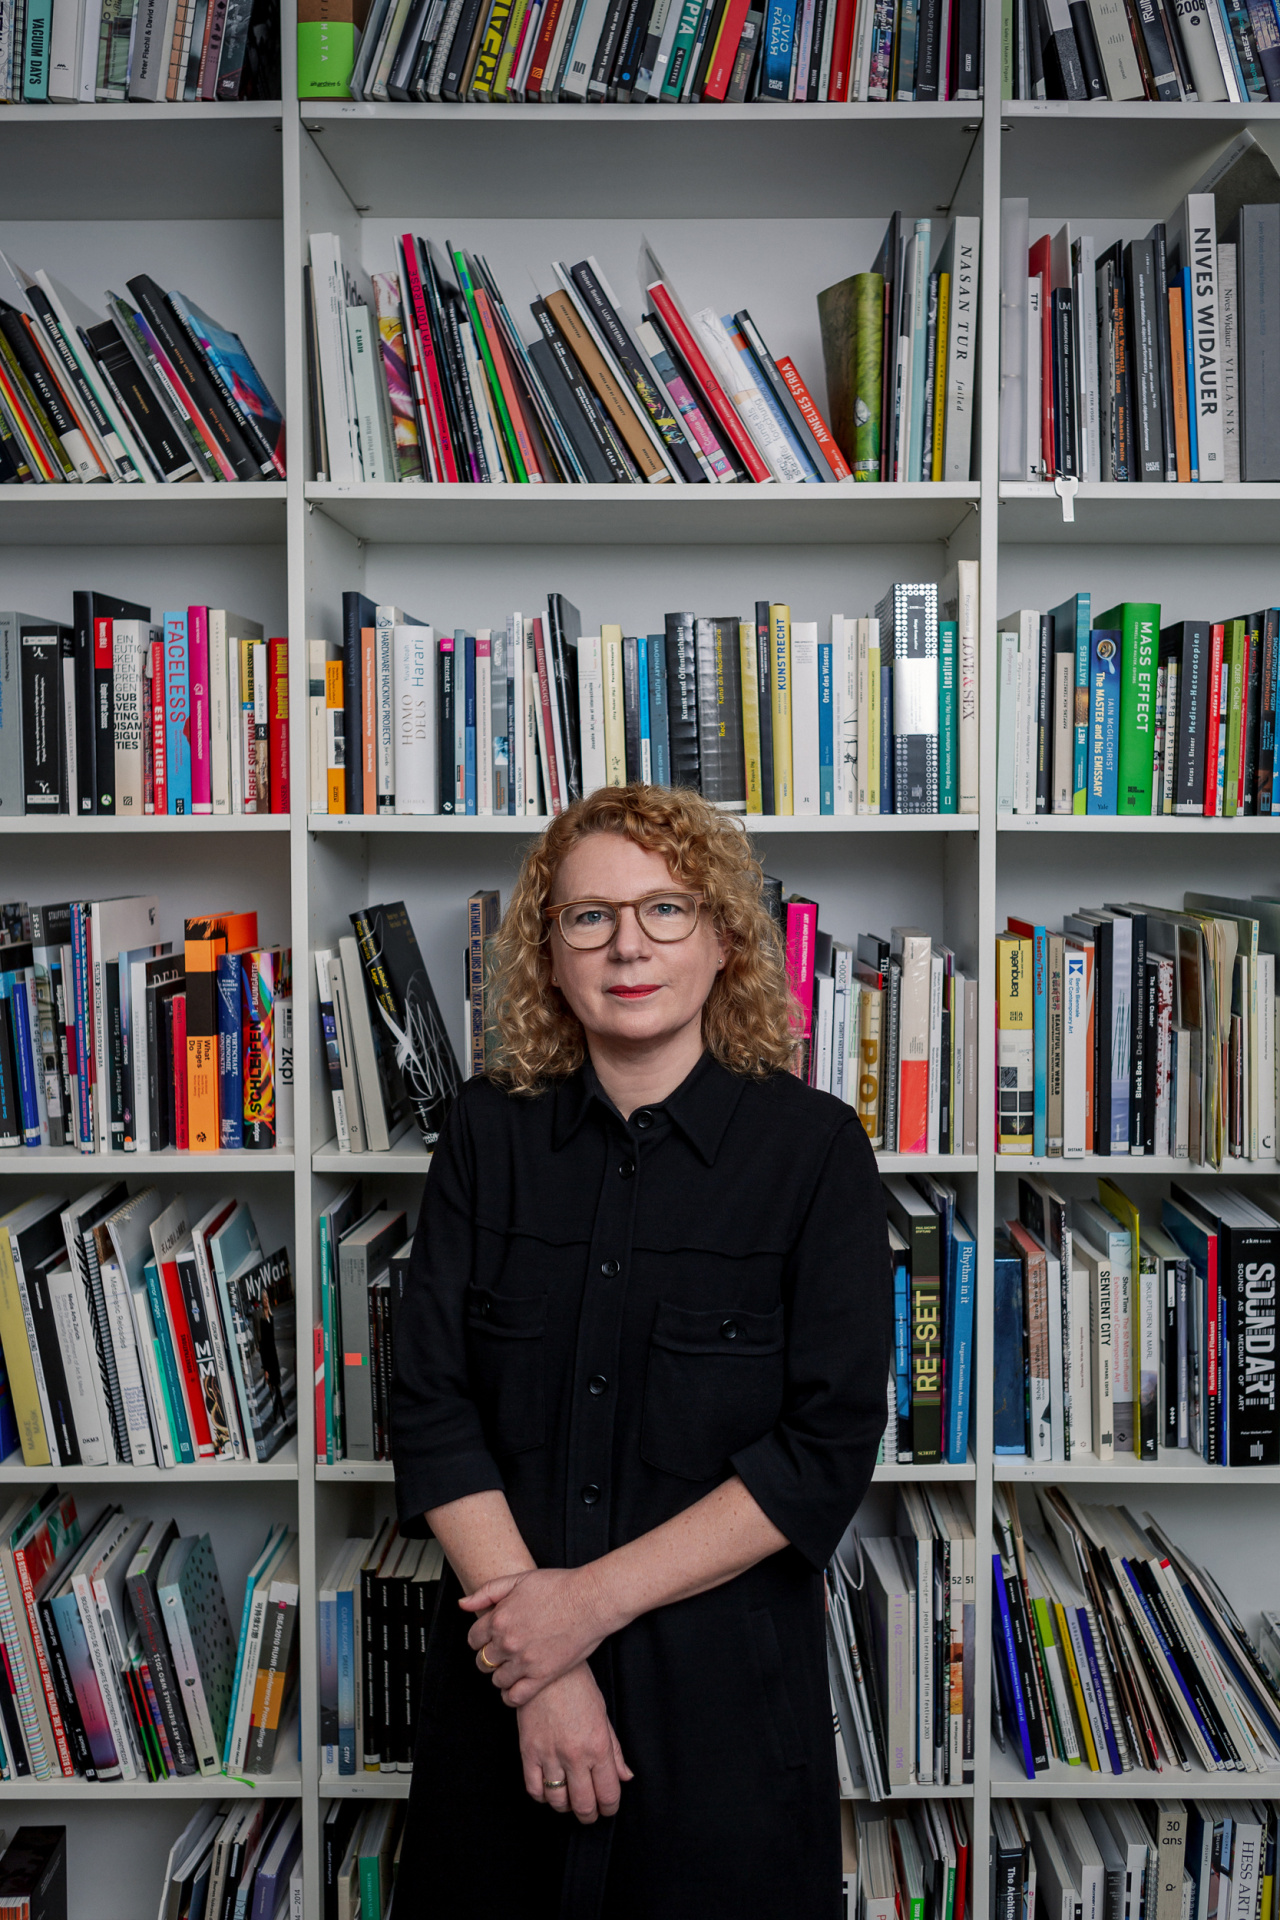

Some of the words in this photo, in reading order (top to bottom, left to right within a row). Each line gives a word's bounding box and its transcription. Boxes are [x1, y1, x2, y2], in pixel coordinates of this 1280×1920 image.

[145, 10, 154, 29] David
[31, 18, 44, 57] VACUUM
[142, 37, 151, 59] Fischli
[1240, 34, 1254, 62] JEREZ
[30, 60, 42, 85] DAYS
[139, 60, 148, 79] Peter
[1194, 228, 1213, 297] NIVES
[579, 270, 593, 288] Robert
[959, 245, 972, 313] NASAN
[1224, 288, 1233, 311] Nives
[42, 313, 61, 338] BETTINA
[56, 338, 78, 370] POUSTTCHI
[416, 305, 433, 356] STATION
[600, 309, 610, 321] LUX
[607, 320, 626, 346] AETERNA
[957, 322, 969, 360] TUR
[1225, 312, 1233, 348] Widauer
[1198, 305, 1217, 416] WIDAUER
[780, 363, 803, 395] ŠTRBA
[1225, 358, 1233, 402] VILLA
[32, 372, 50, 398] MARCO
[48, 399, 68, 428] POLONI
[956, 380, 965, 411] failed
[798, 395, 829, 443] ANNELIES
[1226, 410, 1234, 435] NIX
[117, 635, 133, 643] EIN
[382, 631, 390, 673] HARDWARE
[677, 626, 686, 681] Öffentlichkeit
[776, 619, 786, 690] KUNSTRECHT
[942, 631, 952, 653] Media
[962, 636, 974, 674] LOVE
[1140, 621, 1153, 667] MASS
[168, 620, 186, 723] FACELESS
[276, 643, 288, 675] Internet
[412, 639, 424, 687] Harari
[537, 647, 547, 677] Internet
[942, 656, 952, 688] Locative
[1233, 663, 1241, 684] QUEER
[382, 673, 390, 707] HACKING
[540, 678, 550, 706] Society
[963, 676, 974, 687] &
[1096, 671, 1105, 687] The
[1188, 632, 1200, 734] Medien-Heterotopien
[116, 693, 137, 701] SUB
[155, 705, 162, 717] ES
[276, 678, 288, 719] Generation
[963, 690, 975, 720] SEX
[1095, 689, 1104, 722] MASTER
[1136, 670, 1150, 733] EFFECT
[1232, 686, 1240, 709] ONLINE
[155, 724, 163, 744] IST
[382, 709, 390, 745] PROJECTS
[402, 694, 413, 746] HOMO
[415, 700, 426, 740] DEUS
[1095, 724, 1104, 739] and
[116, 741, 138, 750] TIES
[1094, 741, 1103, 753] his
[1106, 717, 1114, 770] McGILCHRIST
[155, 747, 164, 784] LIEBE
[1094, 755, 1103, 797] EMISSARY
[838, 959, 846, 983] 2000+
[1010, 950, 1019, 997] banquete
[1135, 988, 1143, 1040] Schwarzraum
[189, 1040, 194, 1051] Do
[251, 1021, 262, 1114] SCHLEIFEN
[1134, 1060, 1142, 1075] Box
[961, 1246, 972, 1283] Rhythm
[960, 1284, 970, 1294] in
[1100, 1270, 1110, 1319] SENTIENT
[1238, 1300, 1244, 1311] AS
[1245, 1262, 1276, 1353] SOUND
[1101, 1323, 1110, 1346] CITY
[1238, 1375, 1245, 1385] OF
[1245, 1356, 1275, 1413] ART
[952, 1576, 962, 1585] 52
[965, 1575, 974, 1584] 51
[153, 1653, 162, 1670] 2011
[921, 1635, 930, 1681] international
[158, 1672, 167, 1689] WRO
[263, 1667, 275, 1704] Conference
[163, 1691, 176, 1724] BIENNALE
[172, 1727, 180, 1739] ART
[256, 1706, 268, 1747] Proceedings
[176, 1741, 186, 1764] MEDIA
[343, 1746, 351, 1764] cmv
[895, 1746, 903, 1769] 2016
[1162, 1835, 1183, 1846] ans
[1166, 1821, 1181, 1832] 30
[1241, 1841, 1253, 1881] HESS
[294, 1889, 302, 1907] 2014
[1239, 1884, 1250, 1911] ART
